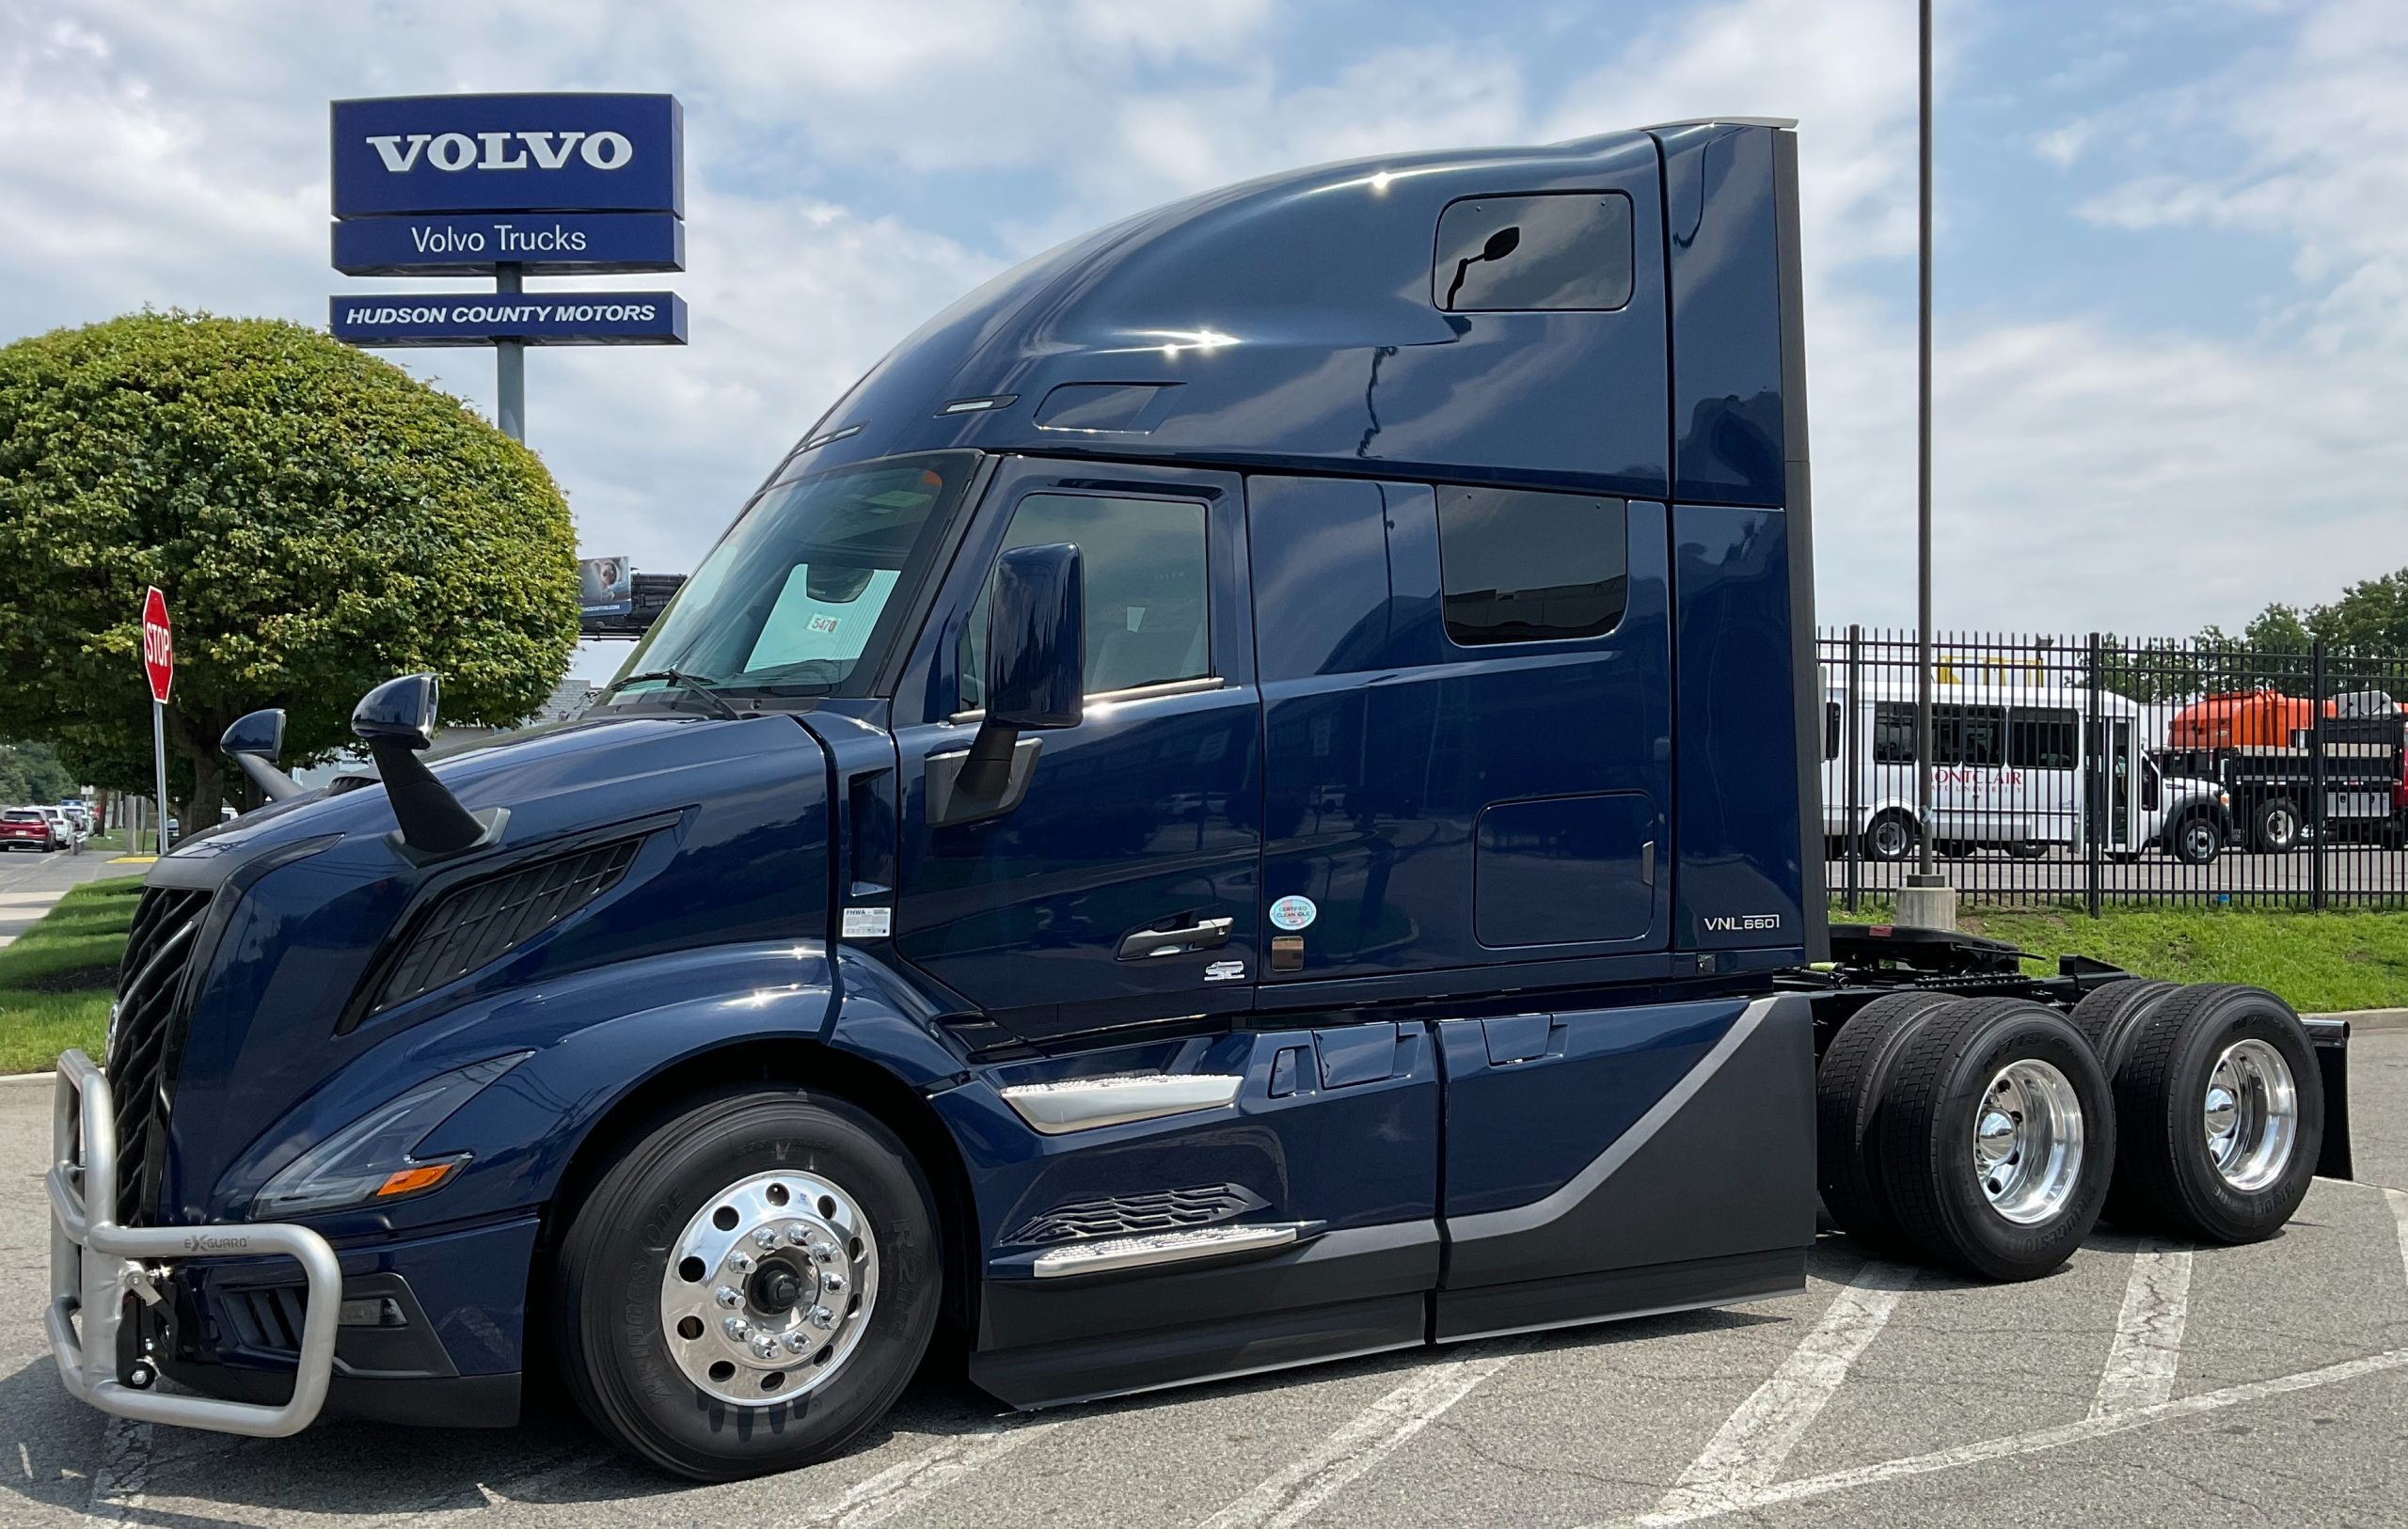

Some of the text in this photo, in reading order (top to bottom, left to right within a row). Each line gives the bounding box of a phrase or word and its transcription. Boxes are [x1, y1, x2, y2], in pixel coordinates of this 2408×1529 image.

[366, 132, 632, 172] VOLVO
[411, 224, 587, 253] Volvo Trucks
[346, 305, 656, 324] HUDSON COUNTY MOTORS
[812, 617, 836, 632] 5470
[146, 621, 170, 667] STOP
[1930, 770, 2021, 784] ONTCLAIR
